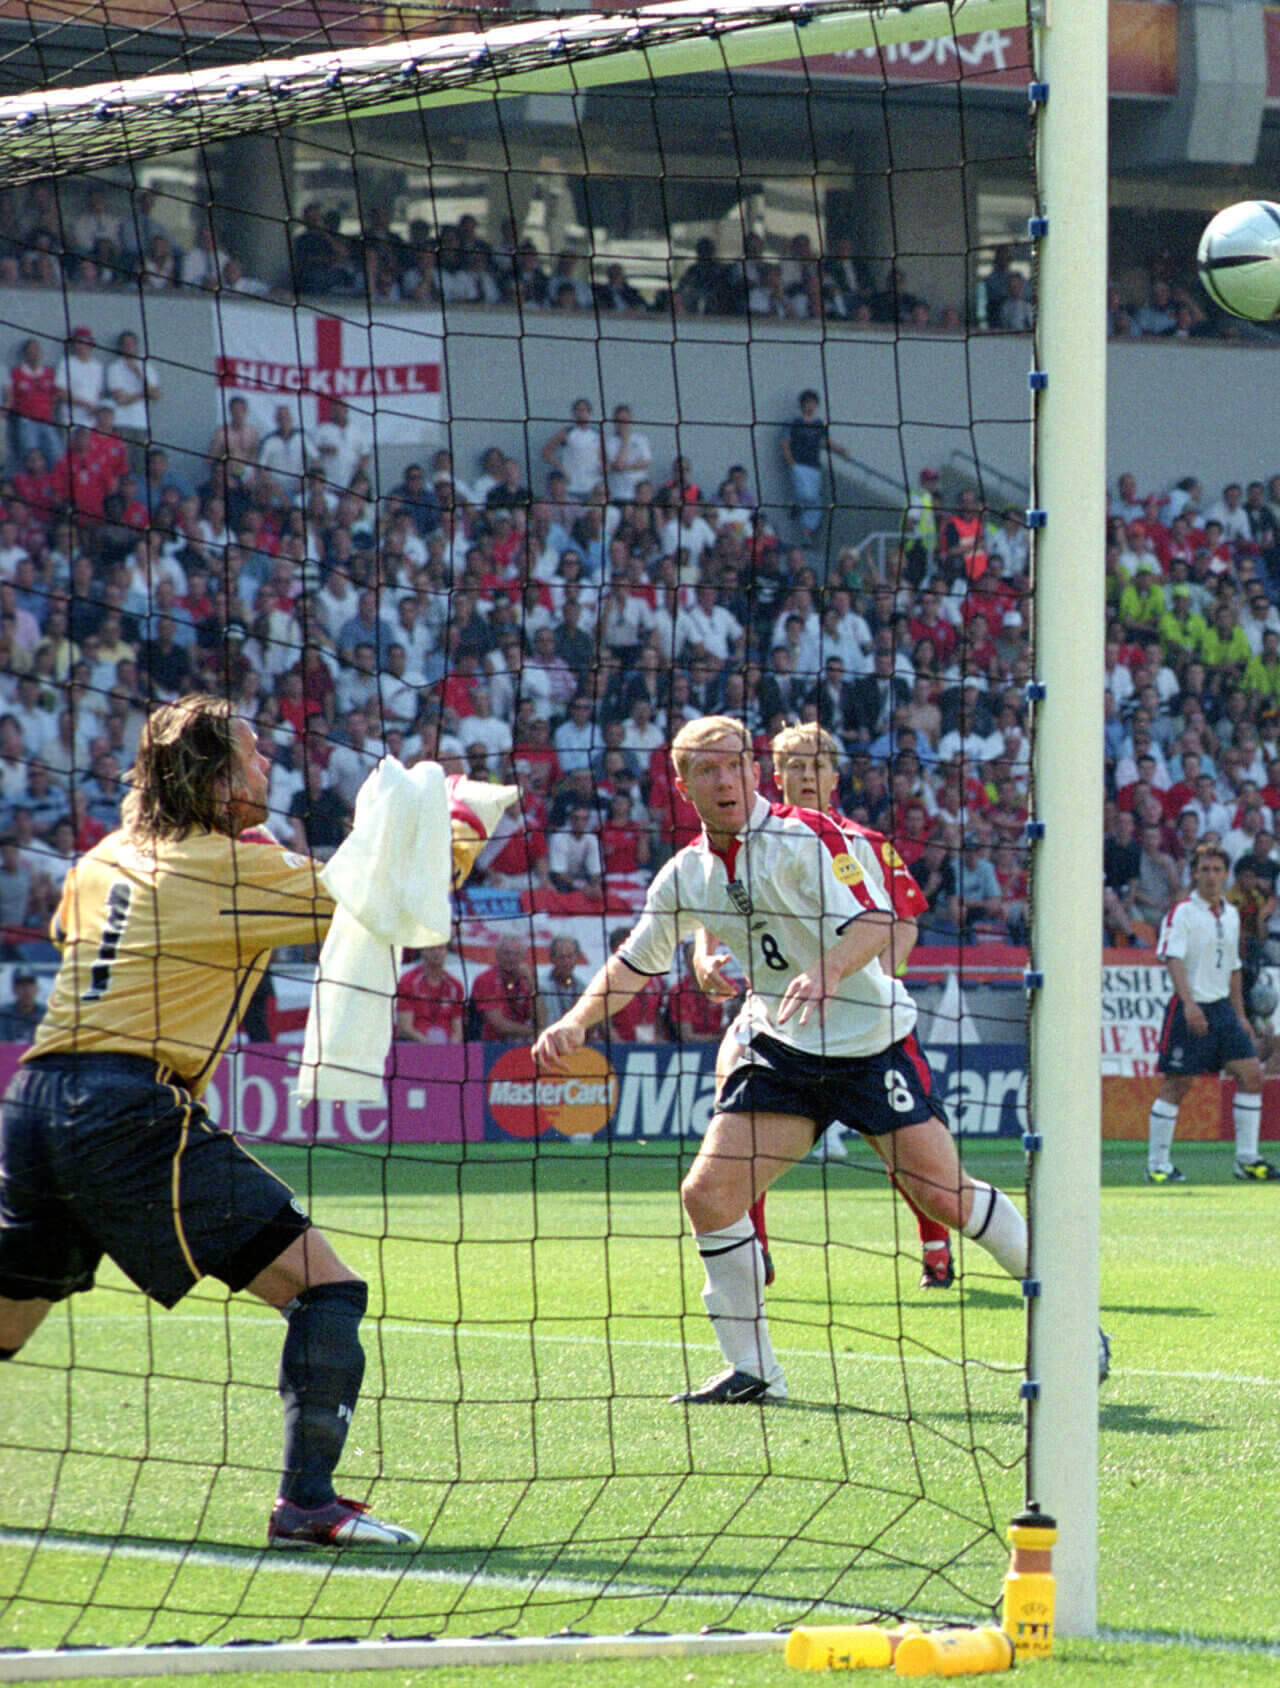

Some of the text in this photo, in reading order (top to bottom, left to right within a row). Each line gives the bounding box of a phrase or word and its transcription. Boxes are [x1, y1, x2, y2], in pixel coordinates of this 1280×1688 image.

[234, 362, 427, 393] HUCKNALL
[80, 883, 131, 1001] 1
[760, 933, 789, 971] 8
[1215, 948, 1224, 969] 2
[488, 1079, 616, 1106] MasterCard
[884, 1069, 915, 1113] 8
